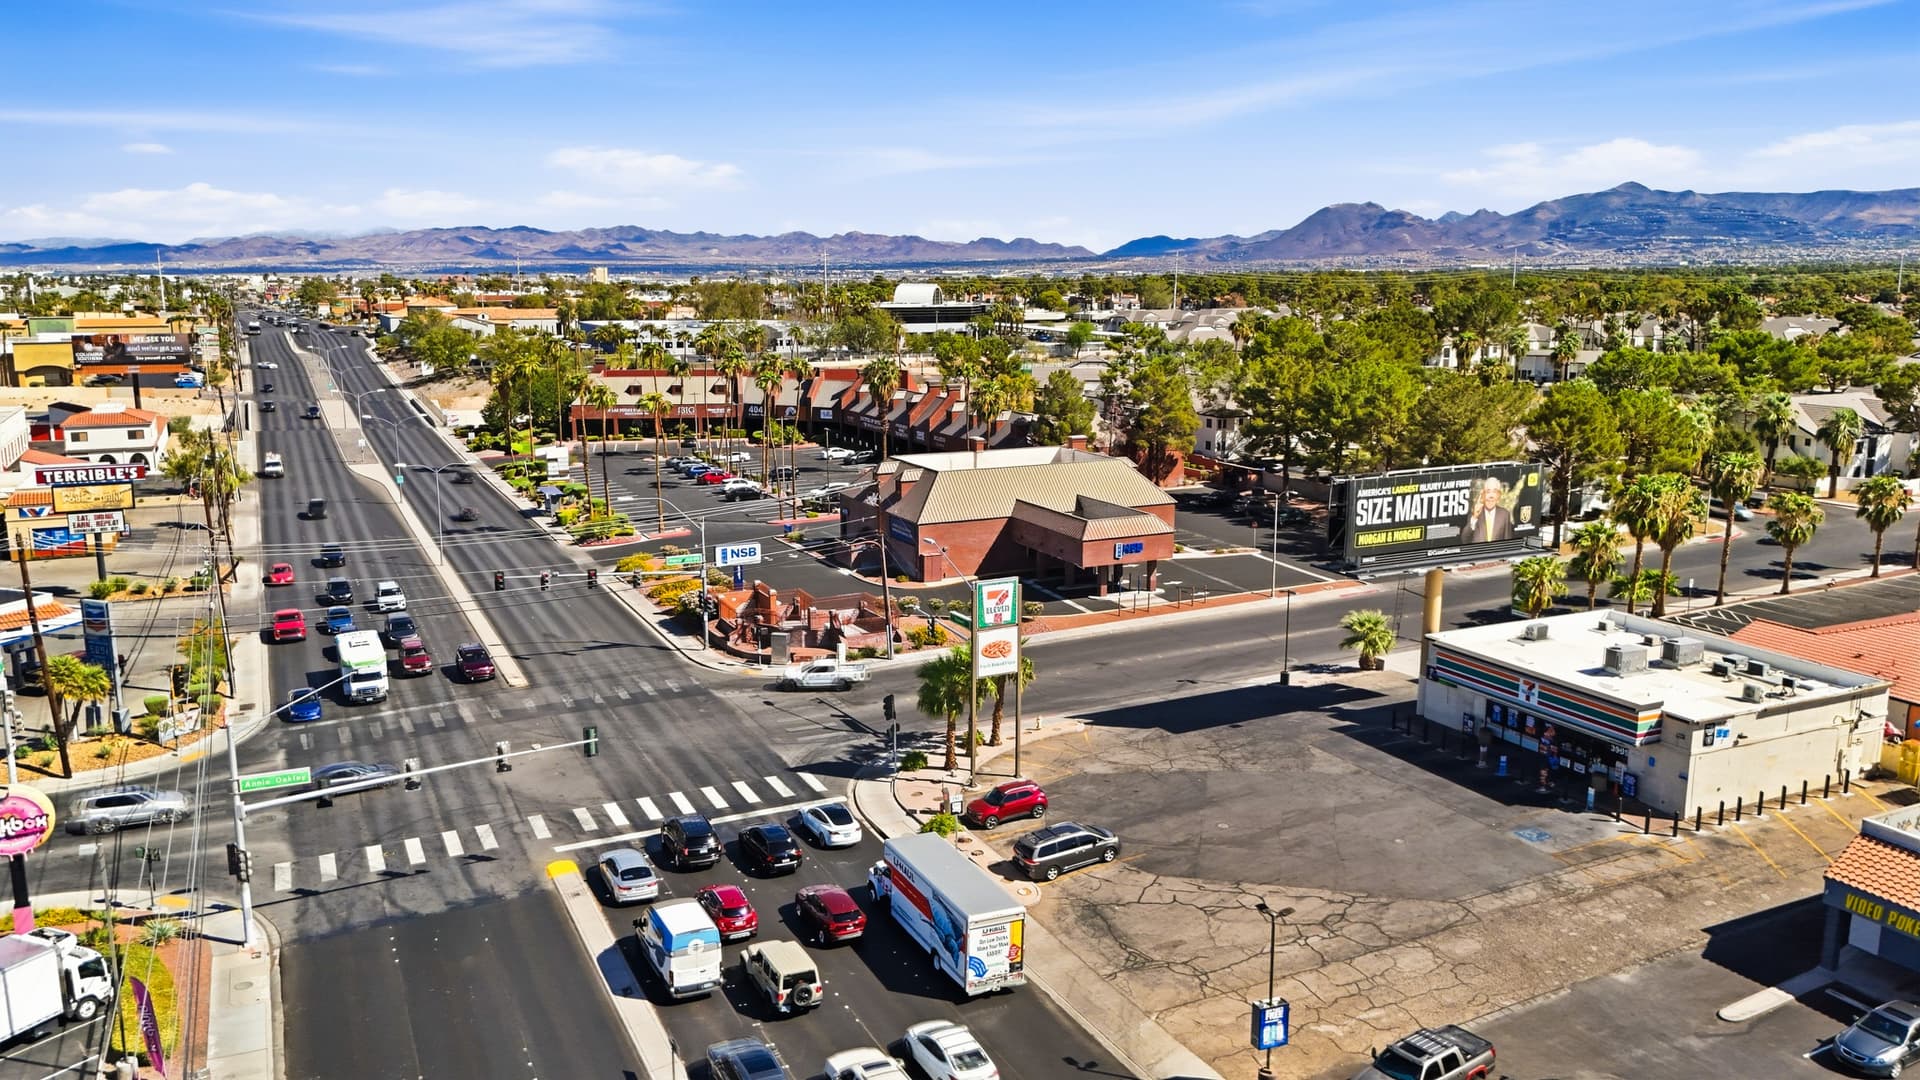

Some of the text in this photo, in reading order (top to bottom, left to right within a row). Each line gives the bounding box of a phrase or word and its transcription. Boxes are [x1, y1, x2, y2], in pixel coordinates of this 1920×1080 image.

[43, 467, 139, 483] TERRIBLE'S
[1357, 487, 1392, 498] AMERICA'S
[1392, 484, 1419, 494] LARGEST
[1419, 482, 1441, 491] INJURY
[1441, 480, 1455, 489] LAW
[1355, 489, 1470, 526] SIZE MATTERS
[1358, 532, 1387, 546] MORGAN
[1387, 531, 1392, 542] &
[1393, 528, 1421, 541] MORGAN
[730, 547, 757, 559] NSB
[244, 774, 306, 788] Annie Oakley
[1845, 893, 1883, 920] VIDEO
